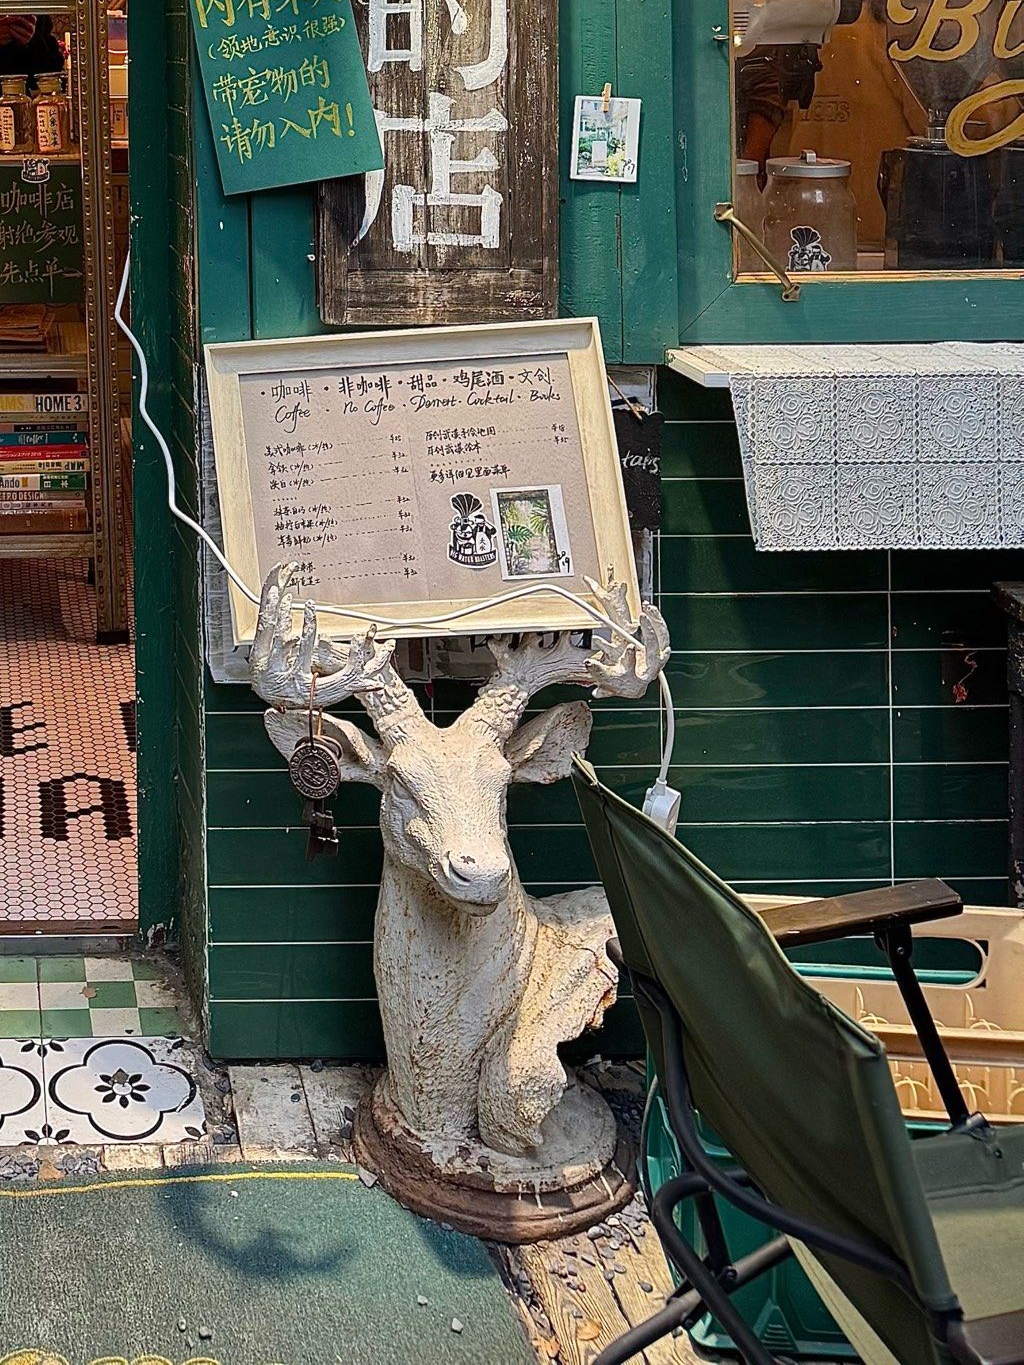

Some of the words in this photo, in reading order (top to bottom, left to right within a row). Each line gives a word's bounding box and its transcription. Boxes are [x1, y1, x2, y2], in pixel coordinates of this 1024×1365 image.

[212, 55, 330, 115] 带宠物的
[0, 181, 74, 218] 咖啡店
[0, 256, 64, 299] 先点单
[36, 395, 72, 412] HOME
[271, 379, 313, 403] 咖啡
[338, 376, 393, 398] 非咖啡
[275, 403, 311, 433] Coffee
